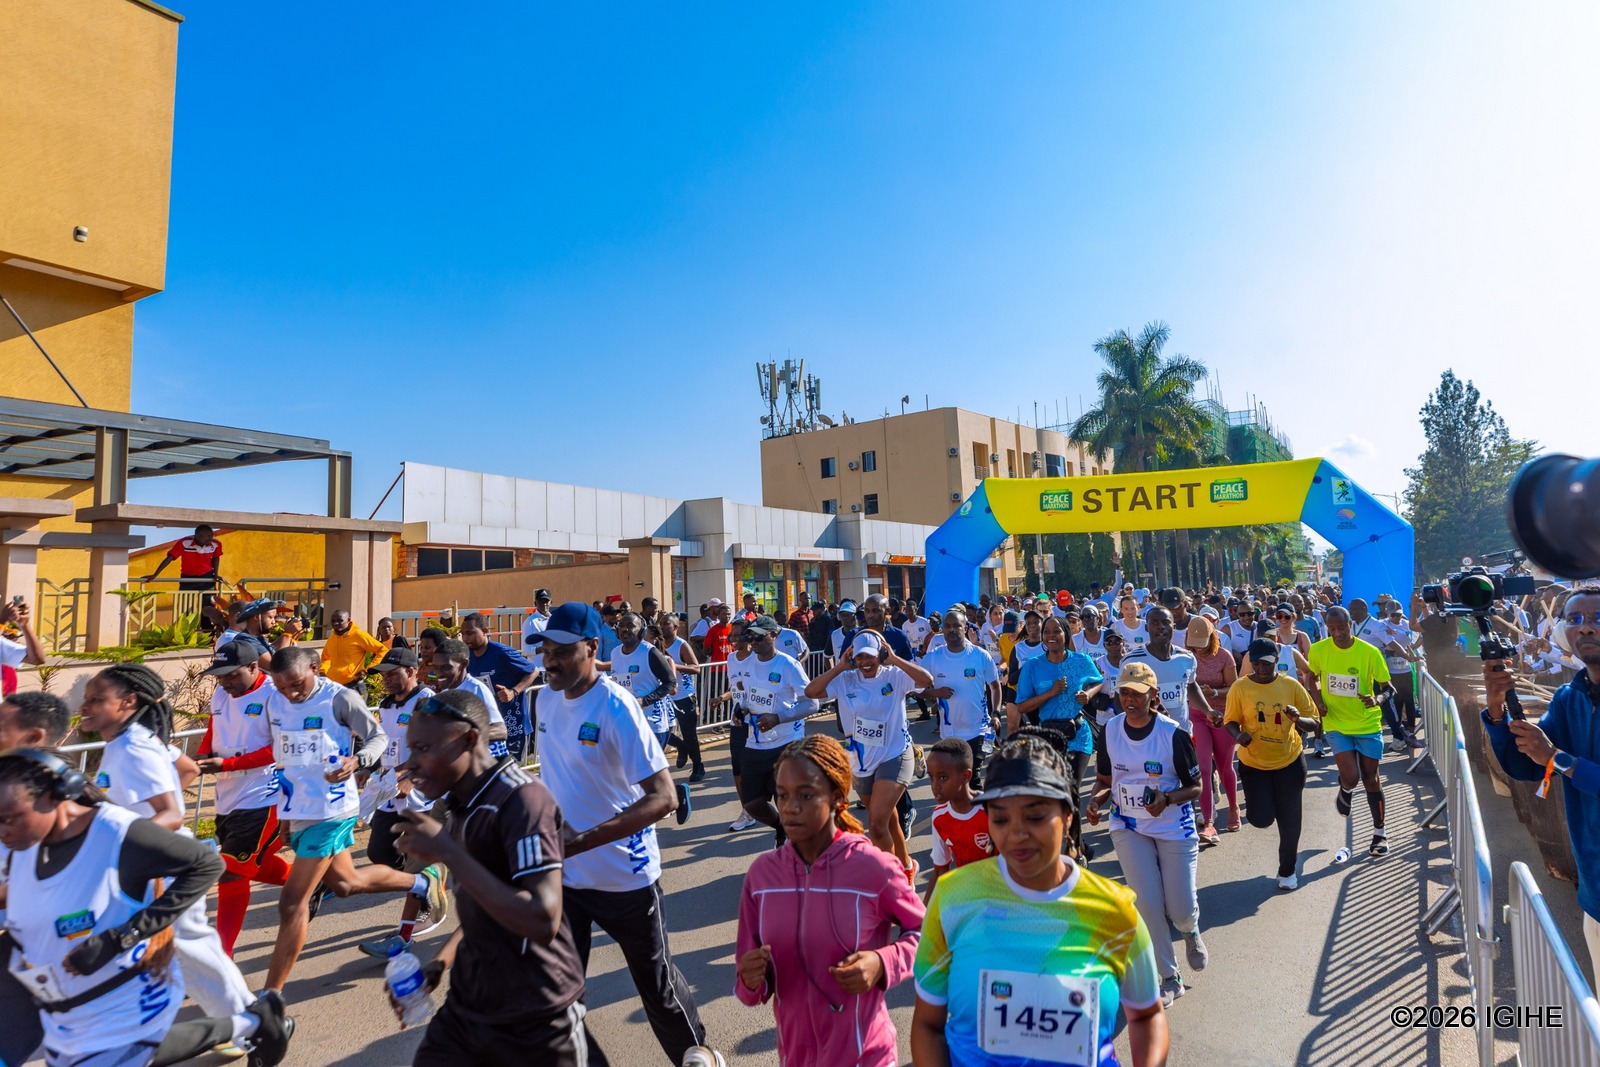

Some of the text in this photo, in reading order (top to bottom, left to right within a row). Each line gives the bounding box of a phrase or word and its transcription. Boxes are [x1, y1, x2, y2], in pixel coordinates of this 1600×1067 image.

[1213, 483, 1244, 494] PEACE
[1043, 494, 1069, 504] PEACE
[1082, 482, 1201, 513] START
[1214, 492, 1244, 500] MARATHON
[1330, 681, 1356, 691] 2409
[750, 694, 772, 706] 0866
[857, 726, 882, 738] 2528
[283, 742, 317, 754] 0154
[384, 747, 396, 756] 45
[1123, 795, 1146, 807] 113
[994, 1003, 1083, 1035] 1457
